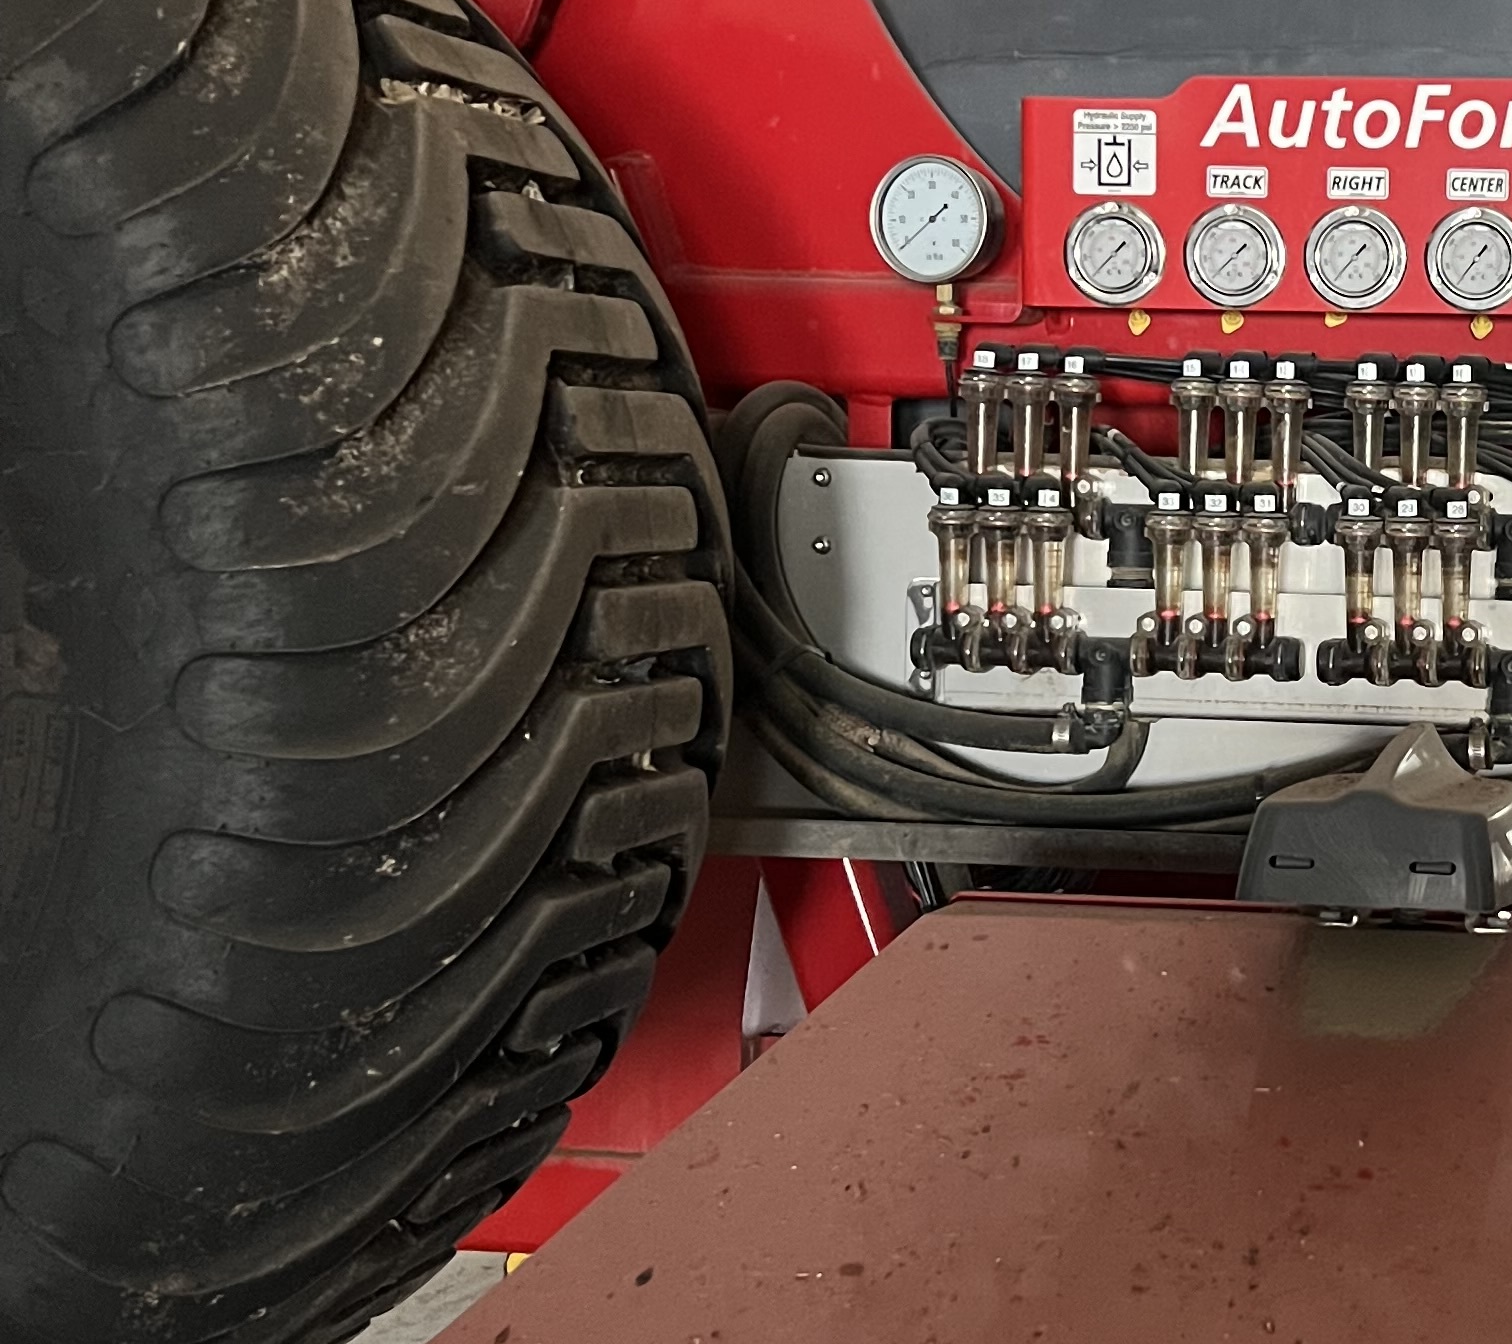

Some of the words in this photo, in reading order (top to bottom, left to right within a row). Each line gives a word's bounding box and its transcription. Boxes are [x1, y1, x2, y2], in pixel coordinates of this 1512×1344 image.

[1121, 112, 1146, 122] Supply
[1078, 122, 1110, 130] Pressure
[1211, 174, 1265, 190] TRACK
[1331, 175, 1386, 191] RIGHT
[1451, 176, 1505, 193] CENTER
